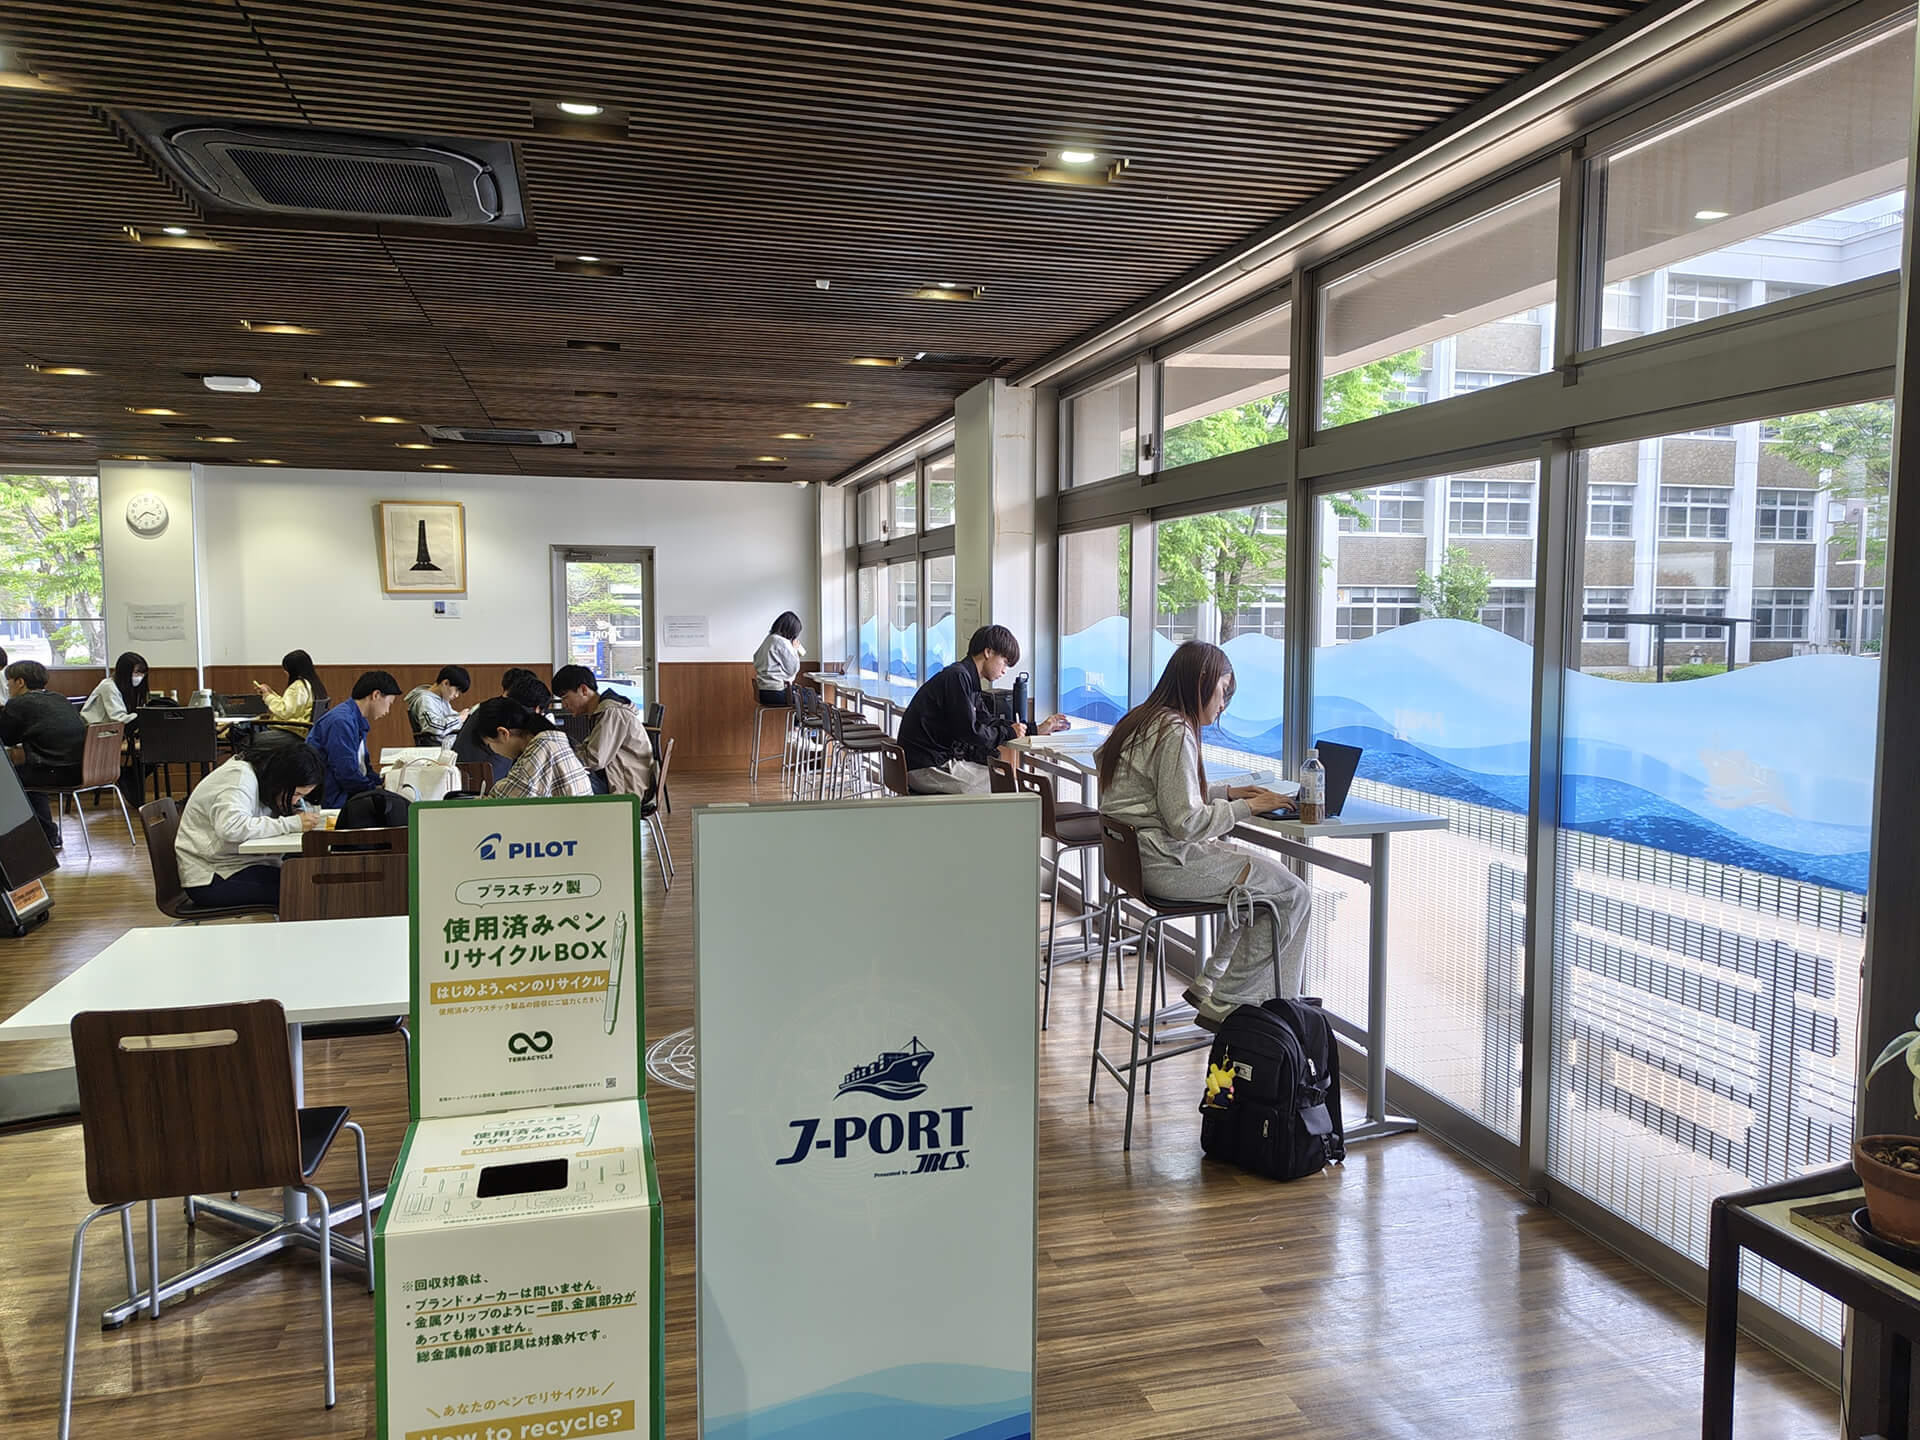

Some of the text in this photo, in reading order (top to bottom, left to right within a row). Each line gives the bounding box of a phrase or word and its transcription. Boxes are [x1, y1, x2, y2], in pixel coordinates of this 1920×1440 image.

[509, 840, 578, 859] PILOT
[477, 879, 581, 899] プラスチック製
[443, 911, 607, 944] 使用済みペン
[443, 940, 608, 970] リサイクルBOX
[436, 974, 606, 998] はじめよう、ペンのリサイクル
[508, 1053, 554, 1063] TERRACYCLE
[775, 1106, 973, 1165] J-PORT
[520, 1408, 623, 1439] recycle?
